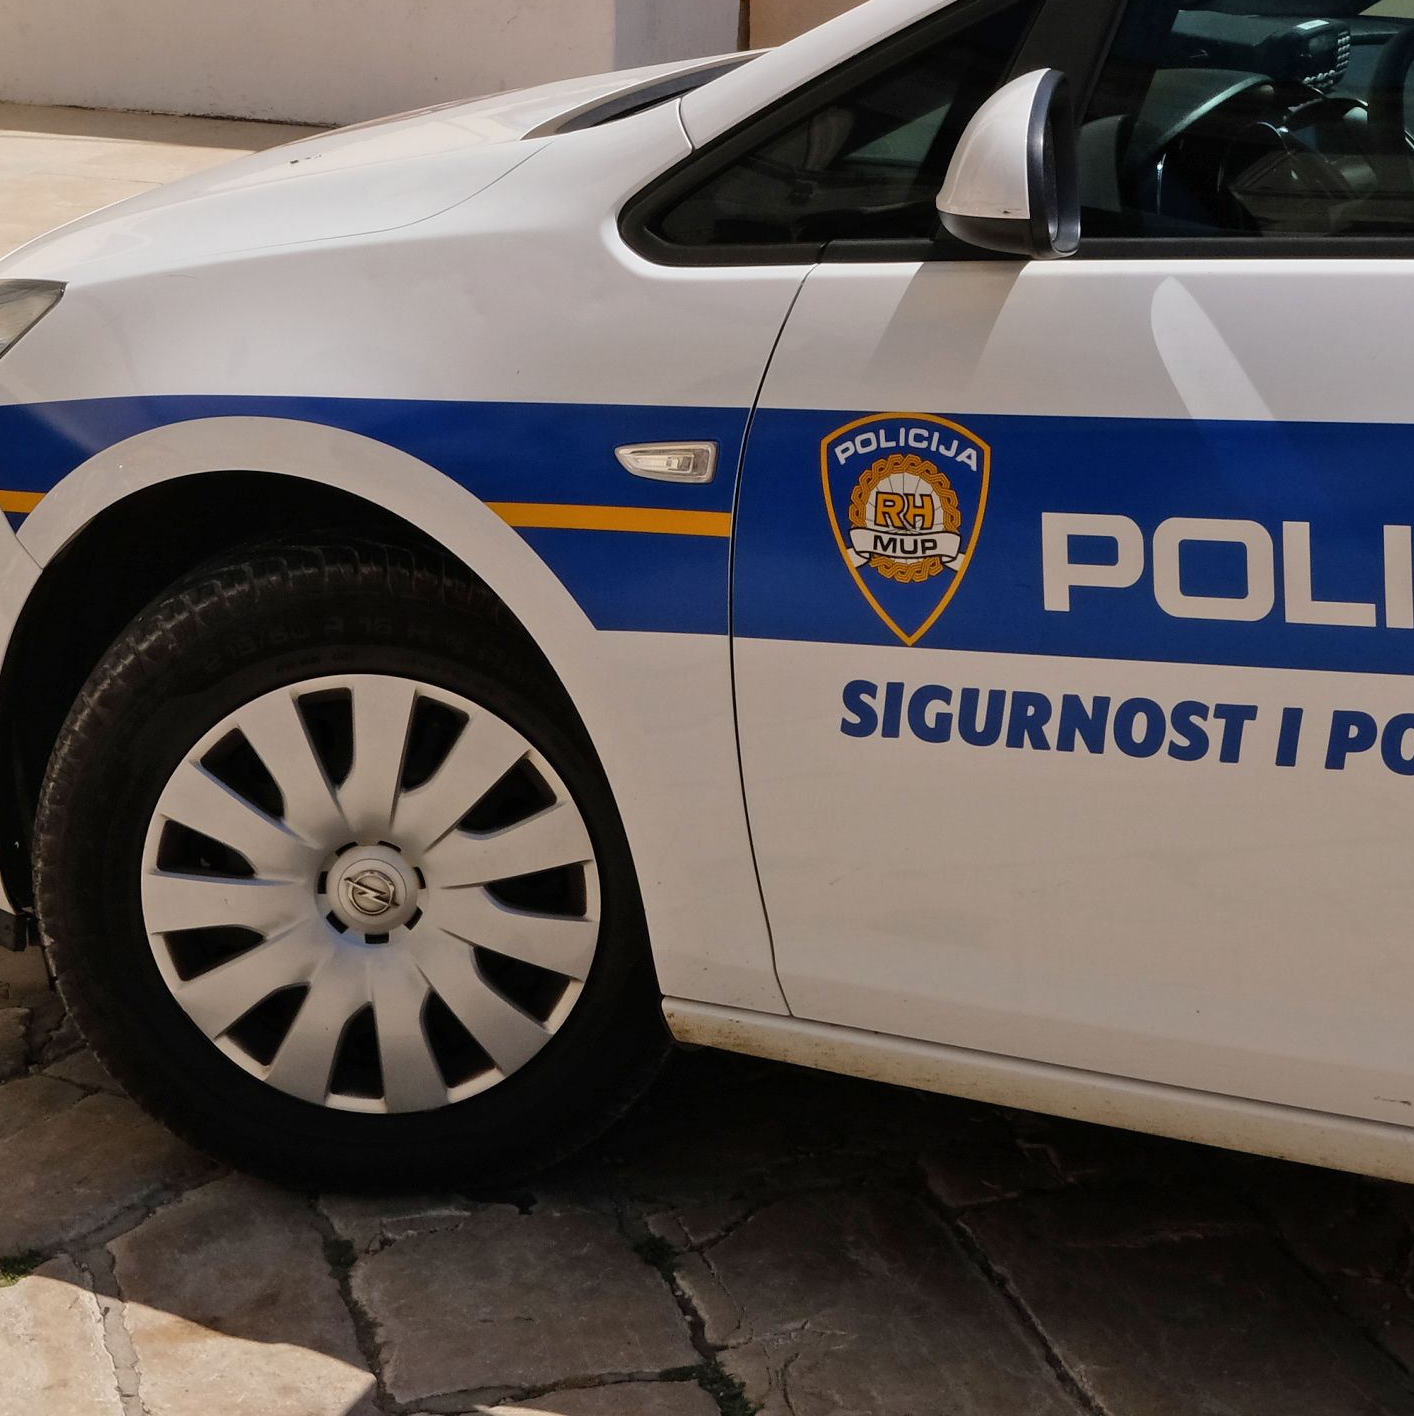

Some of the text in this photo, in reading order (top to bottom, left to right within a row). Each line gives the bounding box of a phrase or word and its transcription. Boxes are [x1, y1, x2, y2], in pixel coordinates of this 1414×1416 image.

[834, 427, 977, 471] POLICIJA
[874, 491, 935, 530] RH
[873, 535, 938, 555] MUP
[839, 678, 1258, 764] SIGURNOST
[1275, 706, 1303, 767] I
